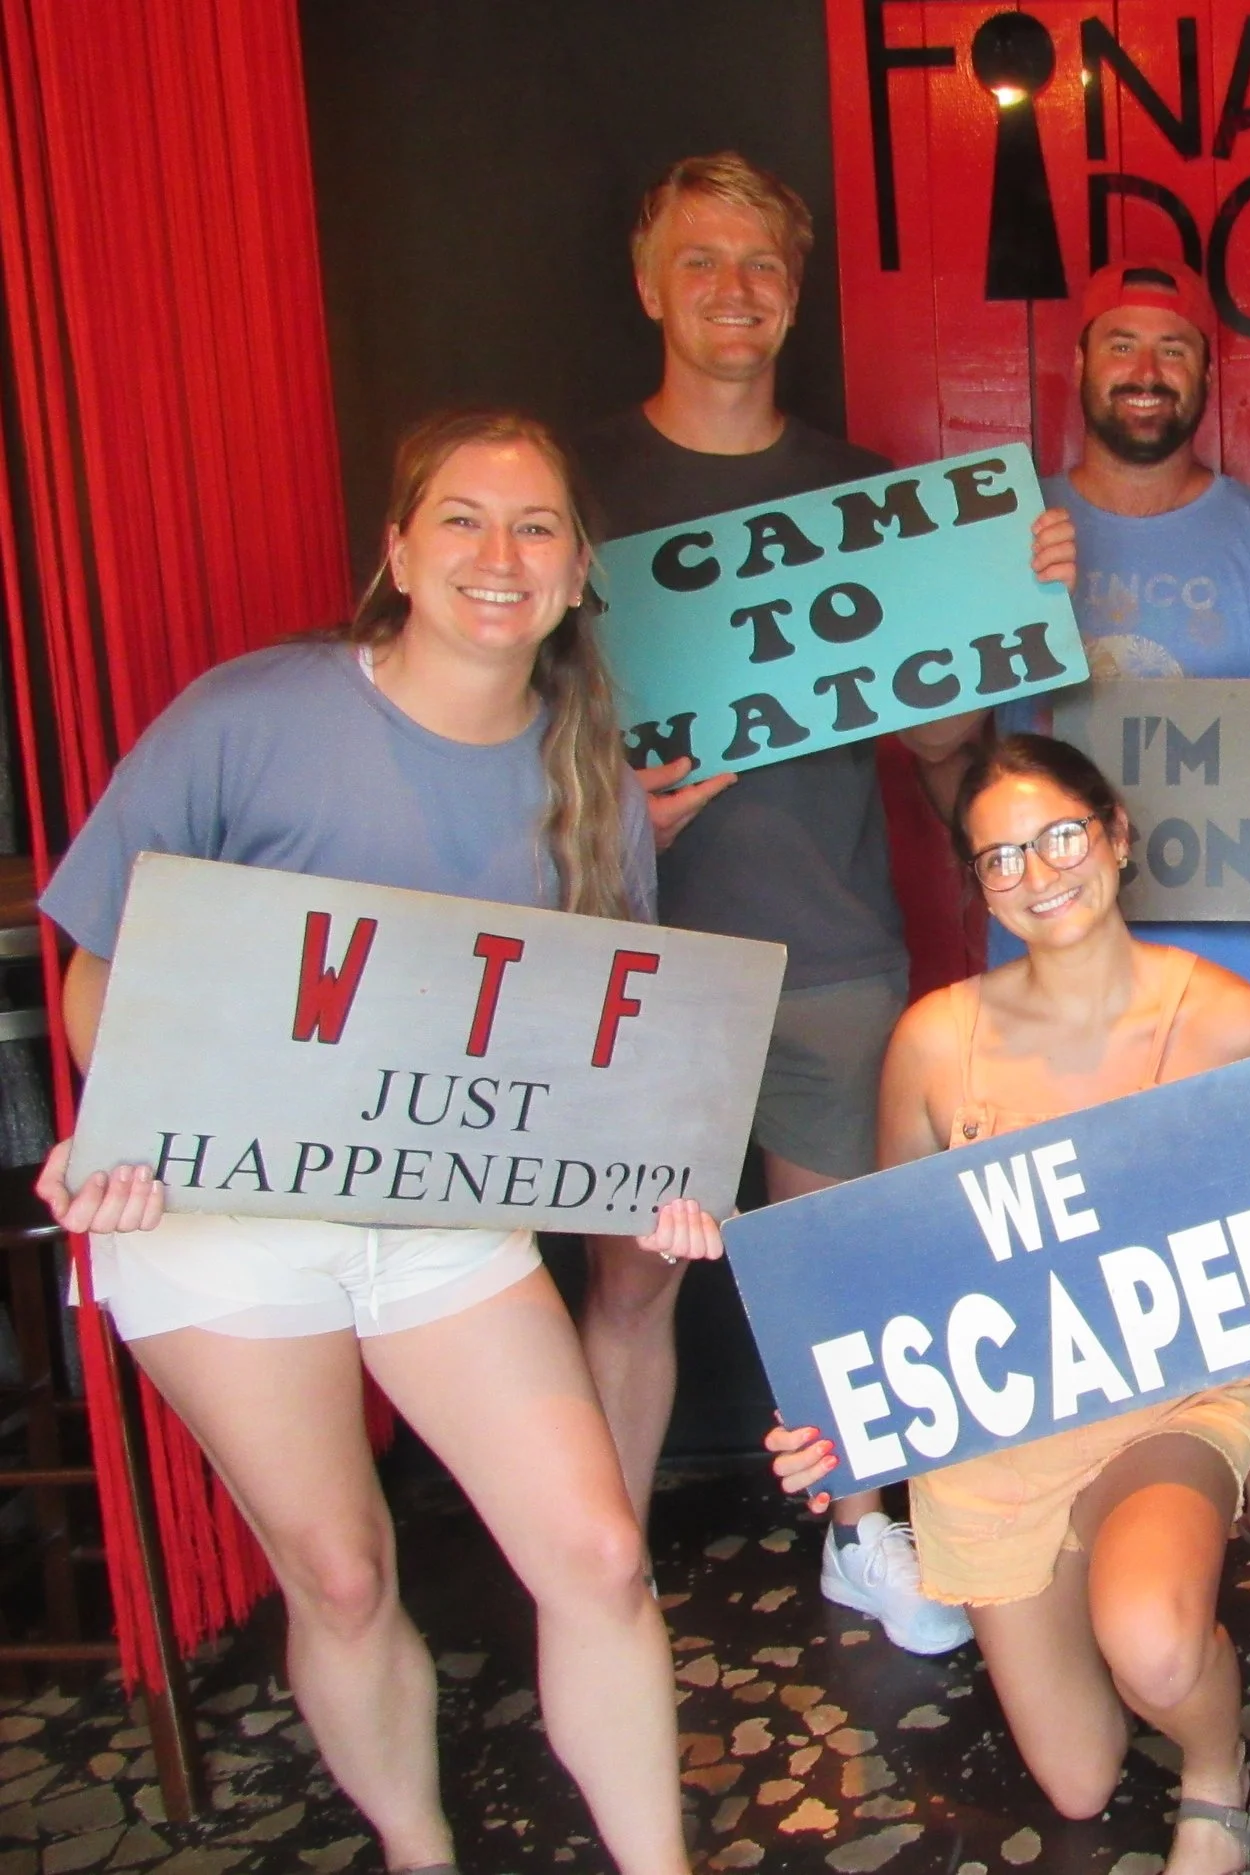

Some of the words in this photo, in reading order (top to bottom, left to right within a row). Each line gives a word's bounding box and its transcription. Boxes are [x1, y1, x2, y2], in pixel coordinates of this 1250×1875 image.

[651, 458, 1018, 592] CAME
[730, 582, 883, 664] TO
[620, 622, 1067, 772] WATCH
[1122, 716, 1221, 786] I'M
[361, 1068, 551, 1134] JUST
[154, 1131, 691, 1214] HAPPENED?!?!
[958, 1139, 1100, 1262] WE
